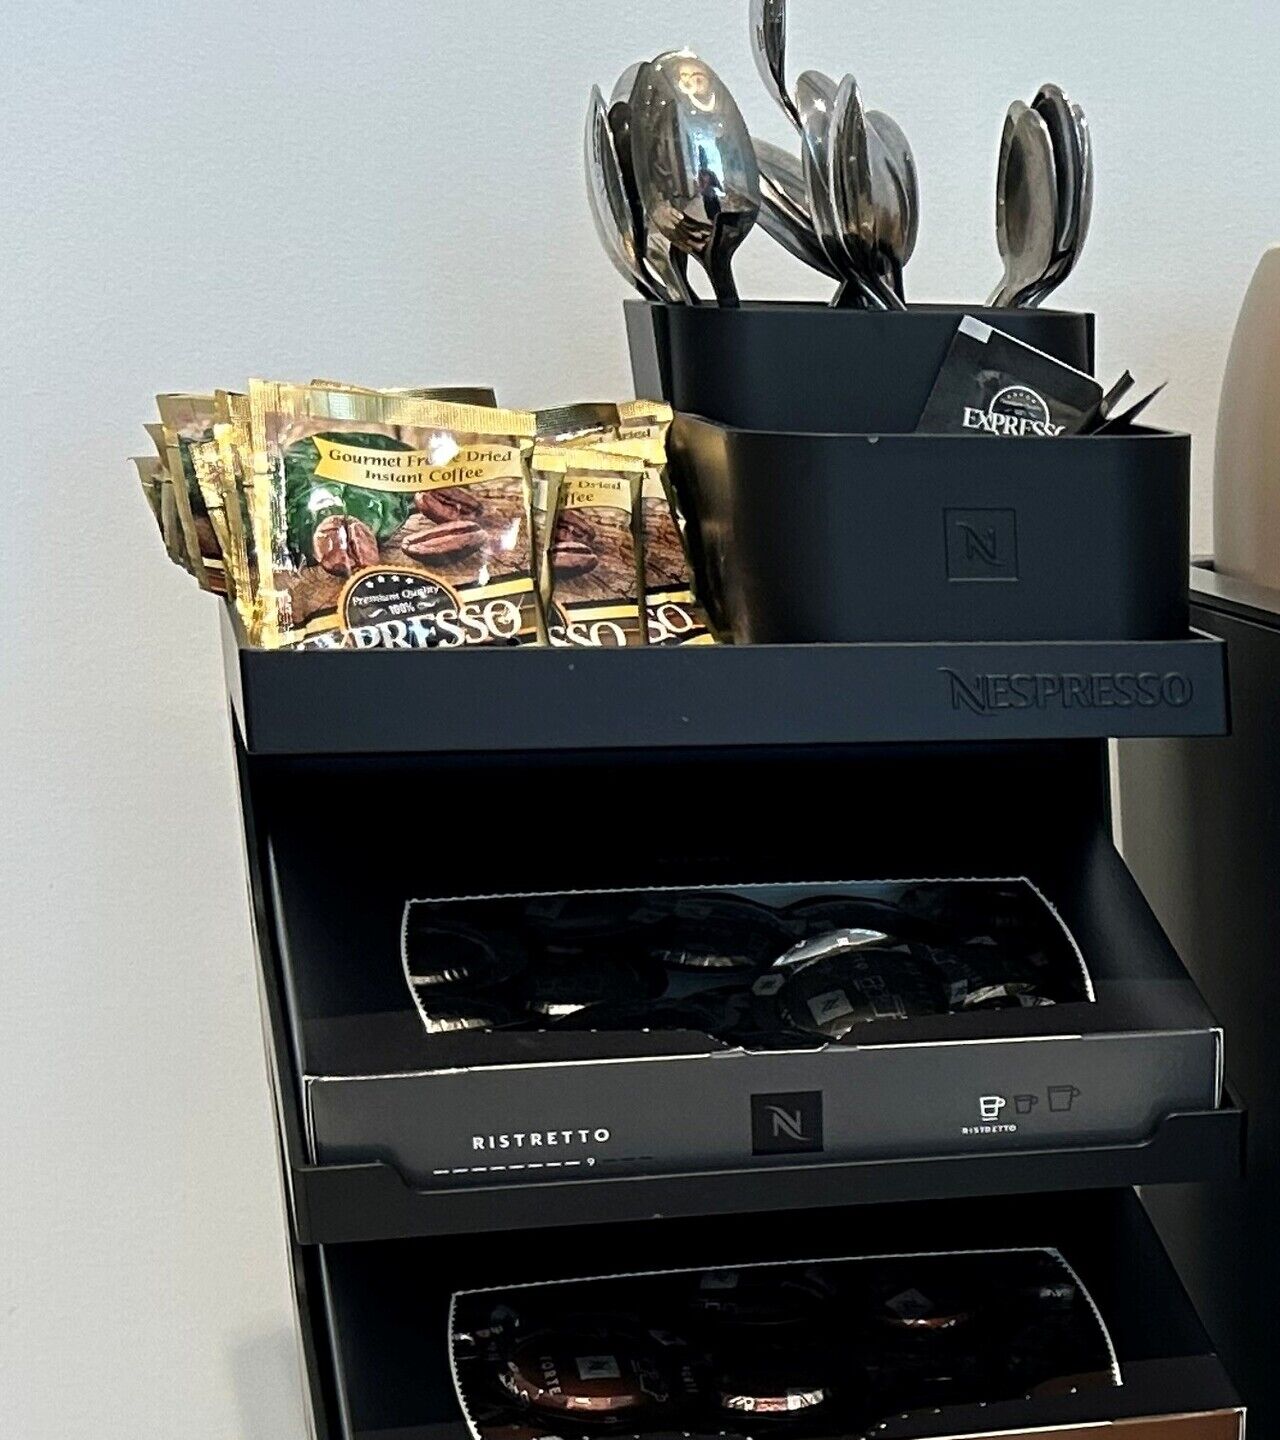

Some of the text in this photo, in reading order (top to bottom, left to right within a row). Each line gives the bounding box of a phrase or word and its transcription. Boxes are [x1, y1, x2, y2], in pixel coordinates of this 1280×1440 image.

[328, 449, 401, 467] Gourmet
[466, 450, 512, 462] Dried
[364, 466, 484, 484] Instant Coffee
[937, 666, 1195, 718] NESPRESSO
[472, 1128, 611, 1150] RISTRETTO
